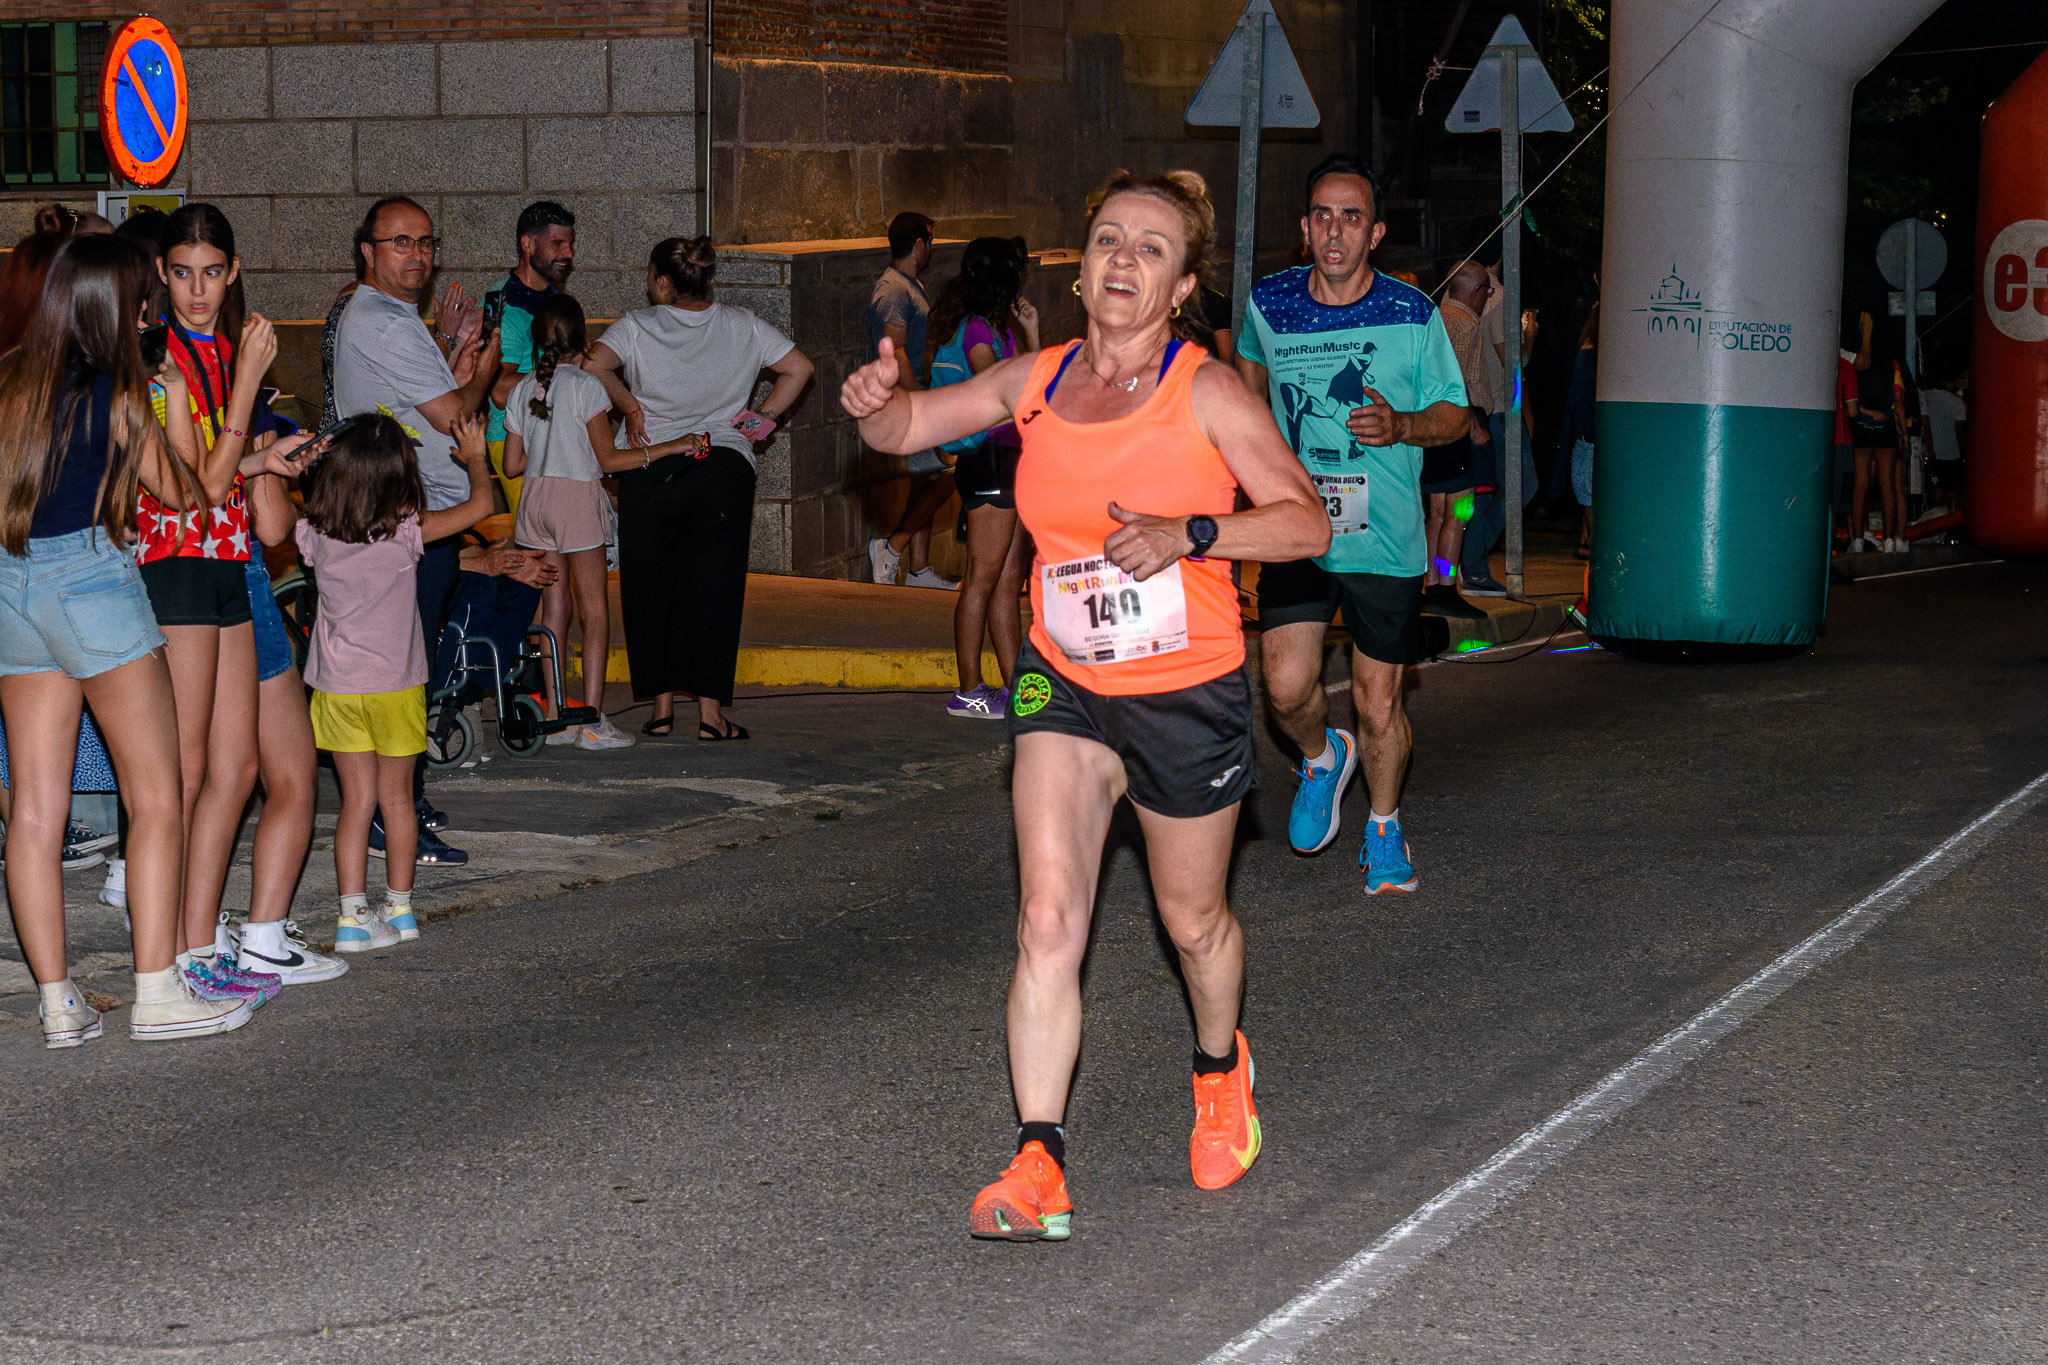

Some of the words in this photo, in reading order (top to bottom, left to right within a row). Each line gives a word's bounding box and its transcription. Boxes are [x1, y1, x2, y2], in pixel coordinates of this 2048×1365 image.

[1779, 324, 1792, 334] DE
[1274, 341, 1360, 358] NightRunMusic
[1343, 476, 1364, 484] UGEN
[1056, 562, 1083, 577] LEGUA
[1083, 588, 1142, 629] 140
